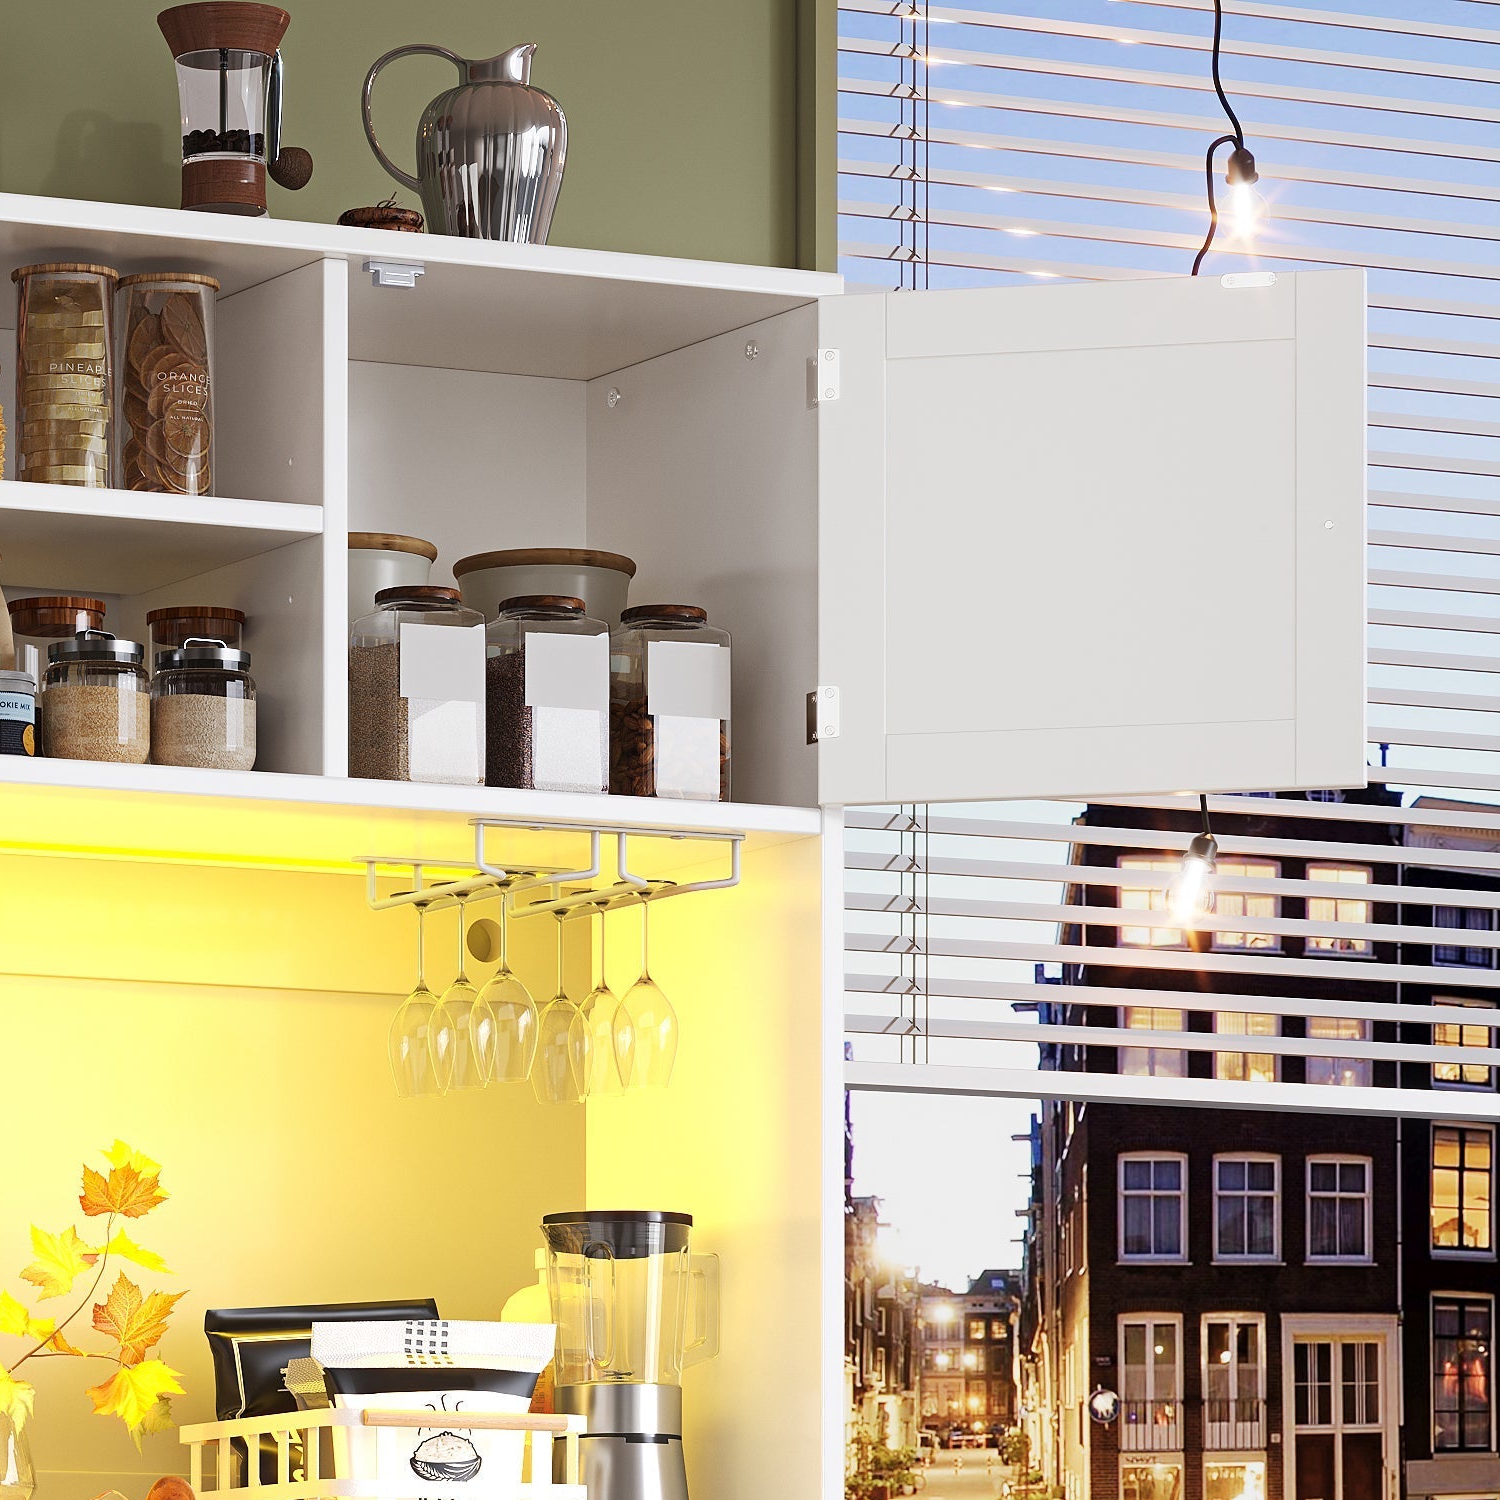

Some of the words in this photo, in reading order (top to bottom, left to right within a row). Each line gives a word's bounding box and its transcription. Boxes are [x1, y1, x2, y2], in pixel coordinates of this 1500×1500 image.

[61, 375, 107, 386] SLICES
[157, 372, 211, 385] ORANGE
[163, 384, 208, 396] SLICES
[20, 702, 31, 711] MIX
